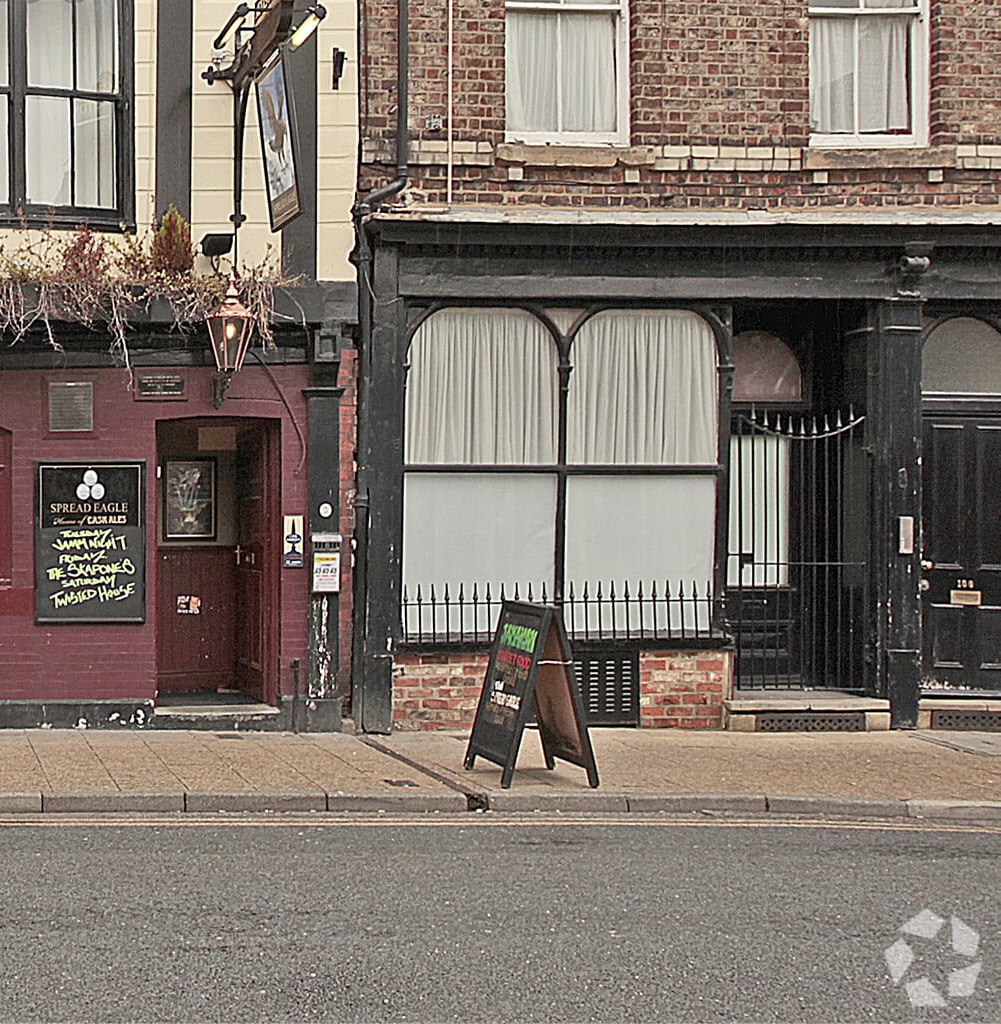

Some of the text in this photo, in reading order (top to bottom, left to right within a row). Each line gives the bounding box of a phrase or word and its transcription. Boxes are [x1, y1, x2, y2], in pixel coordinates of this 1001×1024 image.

[50, 502, 129, 513] SPREAD EAGLE
[86, 515, 107, 525] CASK
[108, 515, 127, 524] ALES
[59, 550, 108, 564] FRIDAY
[46, 567, 67, 580] THE
[61, 574, 116, 588] SATURDAY
[49, 582, 136, 609] TWISTED HOUSE
